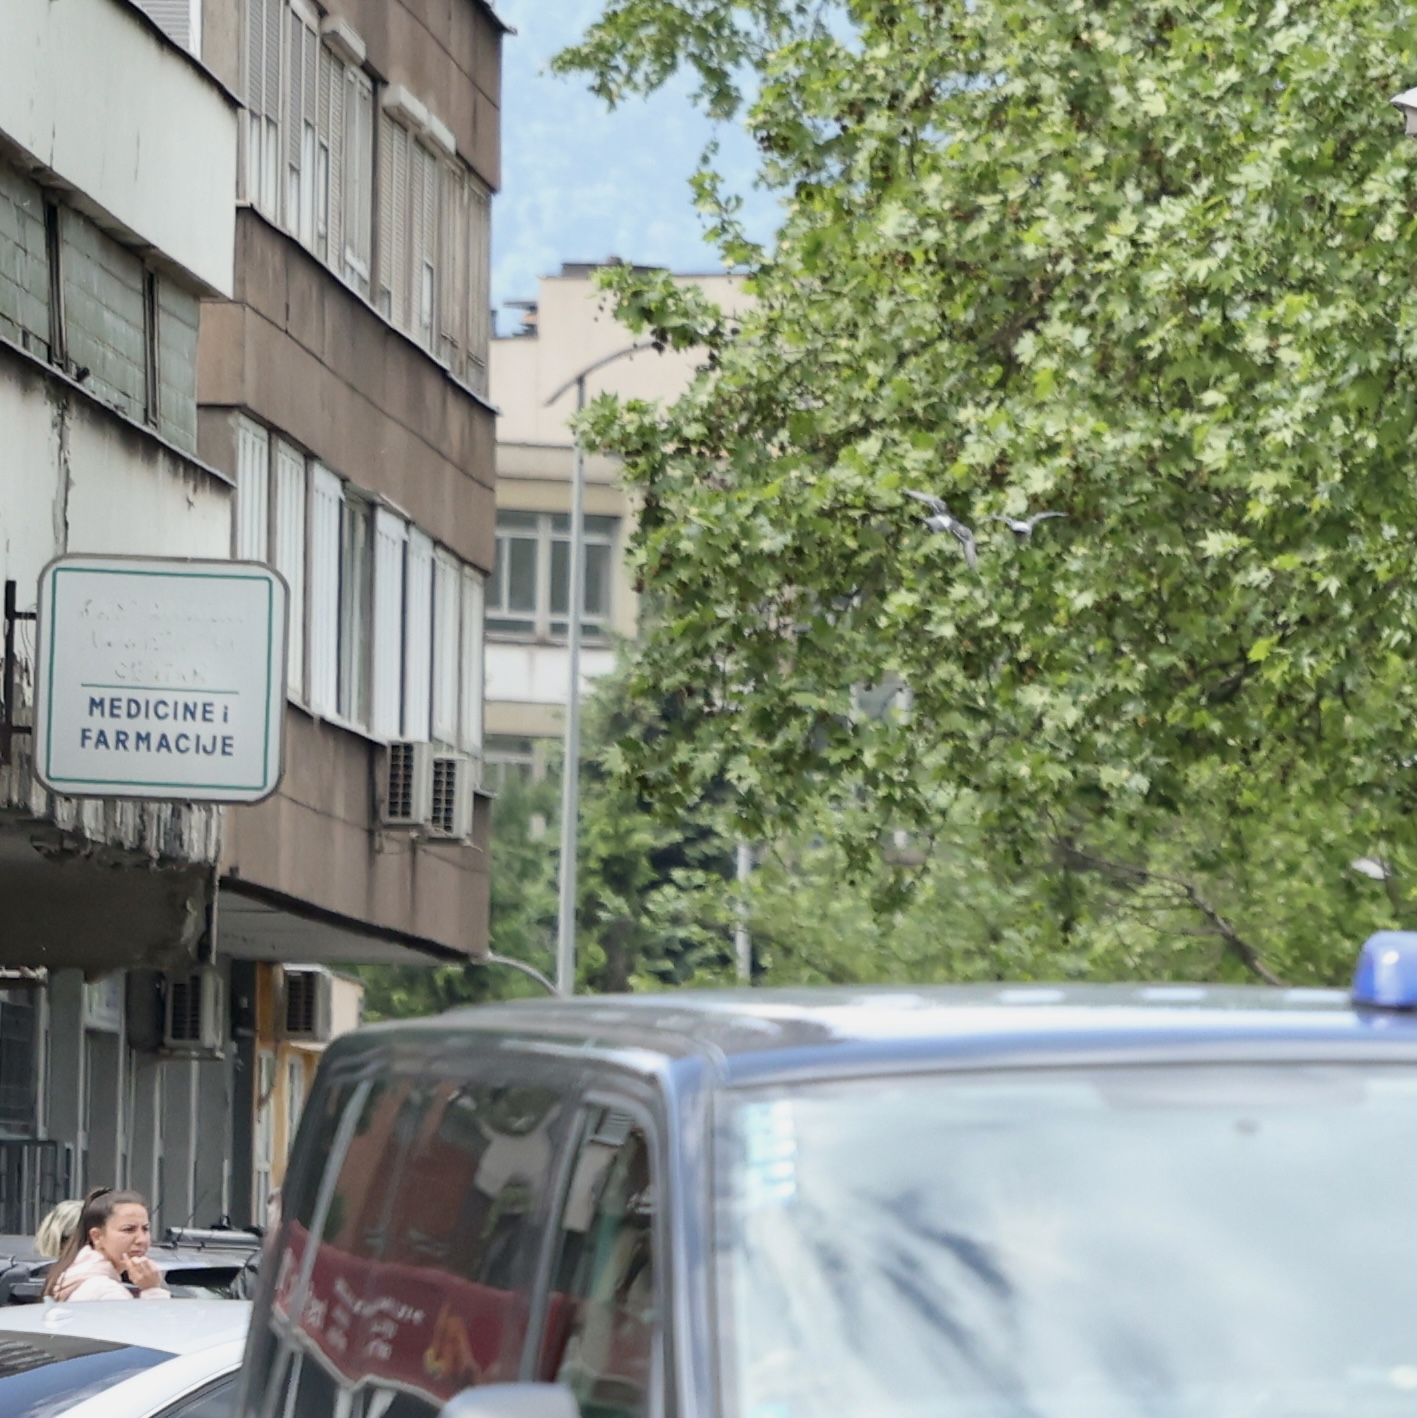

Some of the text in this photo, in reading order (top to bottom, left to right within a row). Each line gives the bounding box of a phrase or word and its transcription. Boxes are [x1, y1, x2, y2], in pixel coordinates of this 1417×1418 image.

[88, 696, 229, 723] MEDICINE i
[80, 728, 235, 756] FARMACIJE
